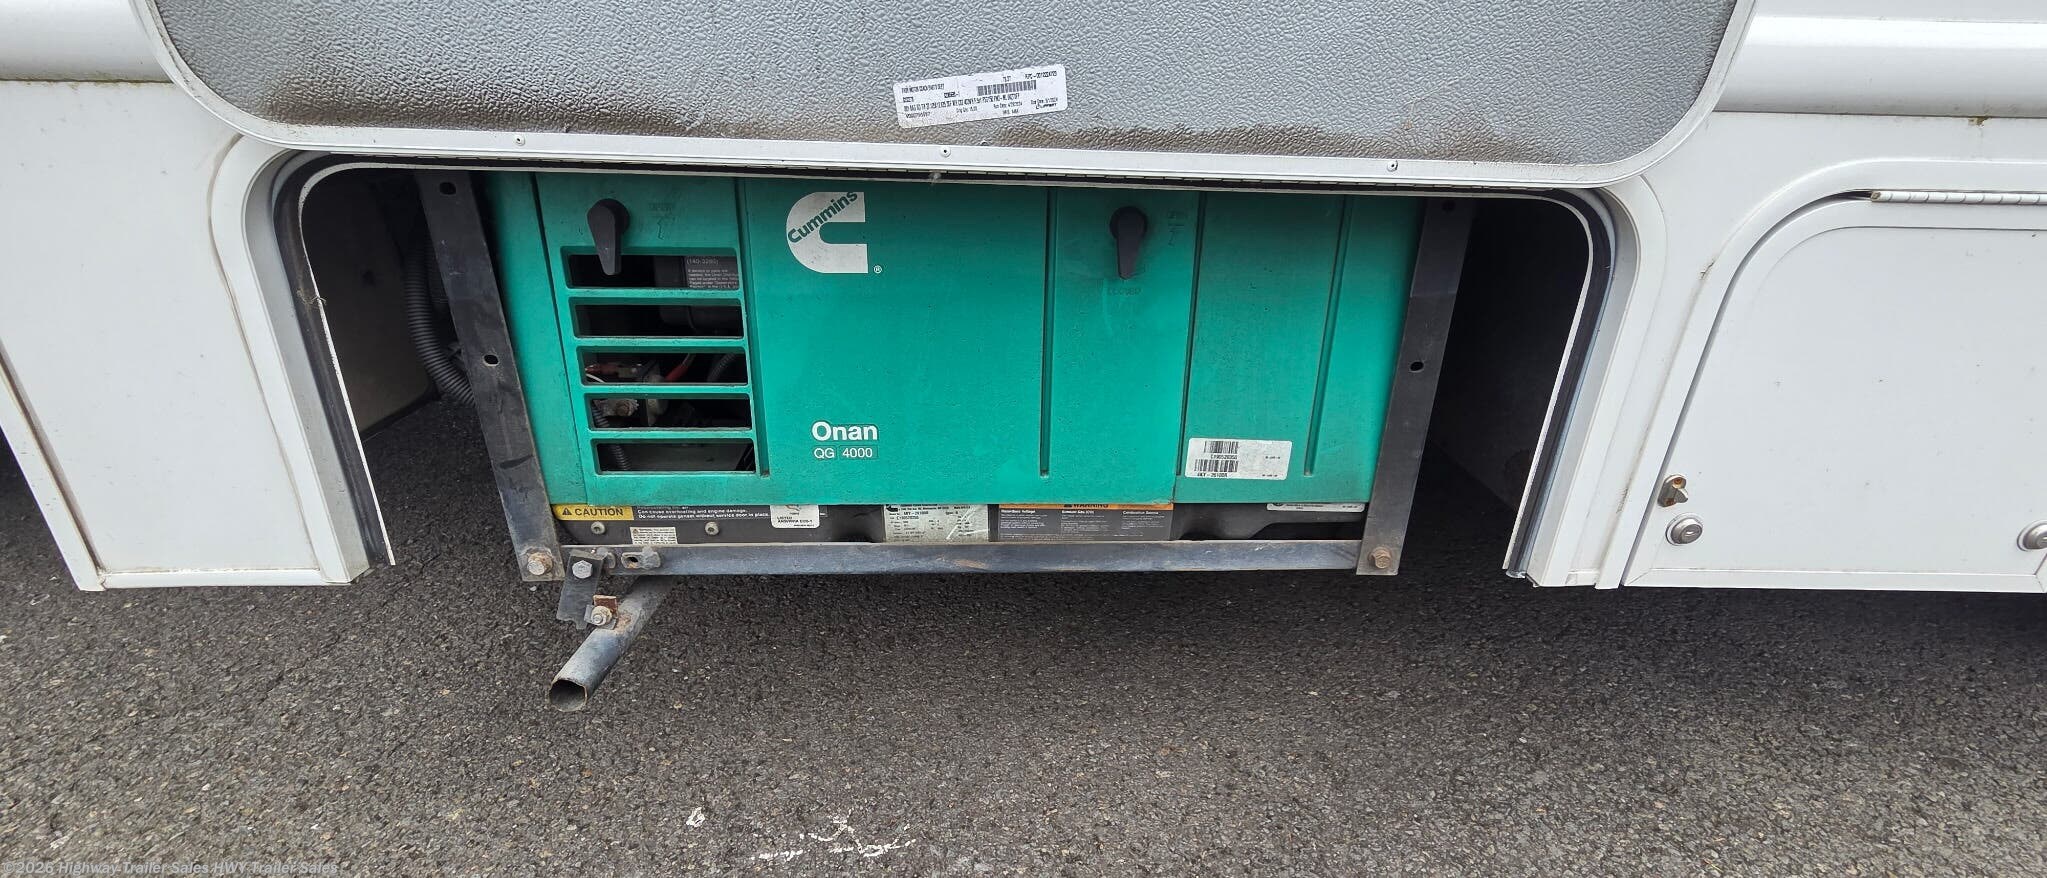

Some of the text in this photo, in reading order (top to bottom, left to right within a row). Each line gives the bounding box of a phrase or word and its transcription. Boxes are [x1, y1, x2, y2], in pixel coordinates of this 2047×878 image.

[788, 191, 858, 243] Cummins
[811, 421, 878, 441] Onan
[813, 447, 873, 459] QG 4000
[574, 508, 624, 517] CAUTION
